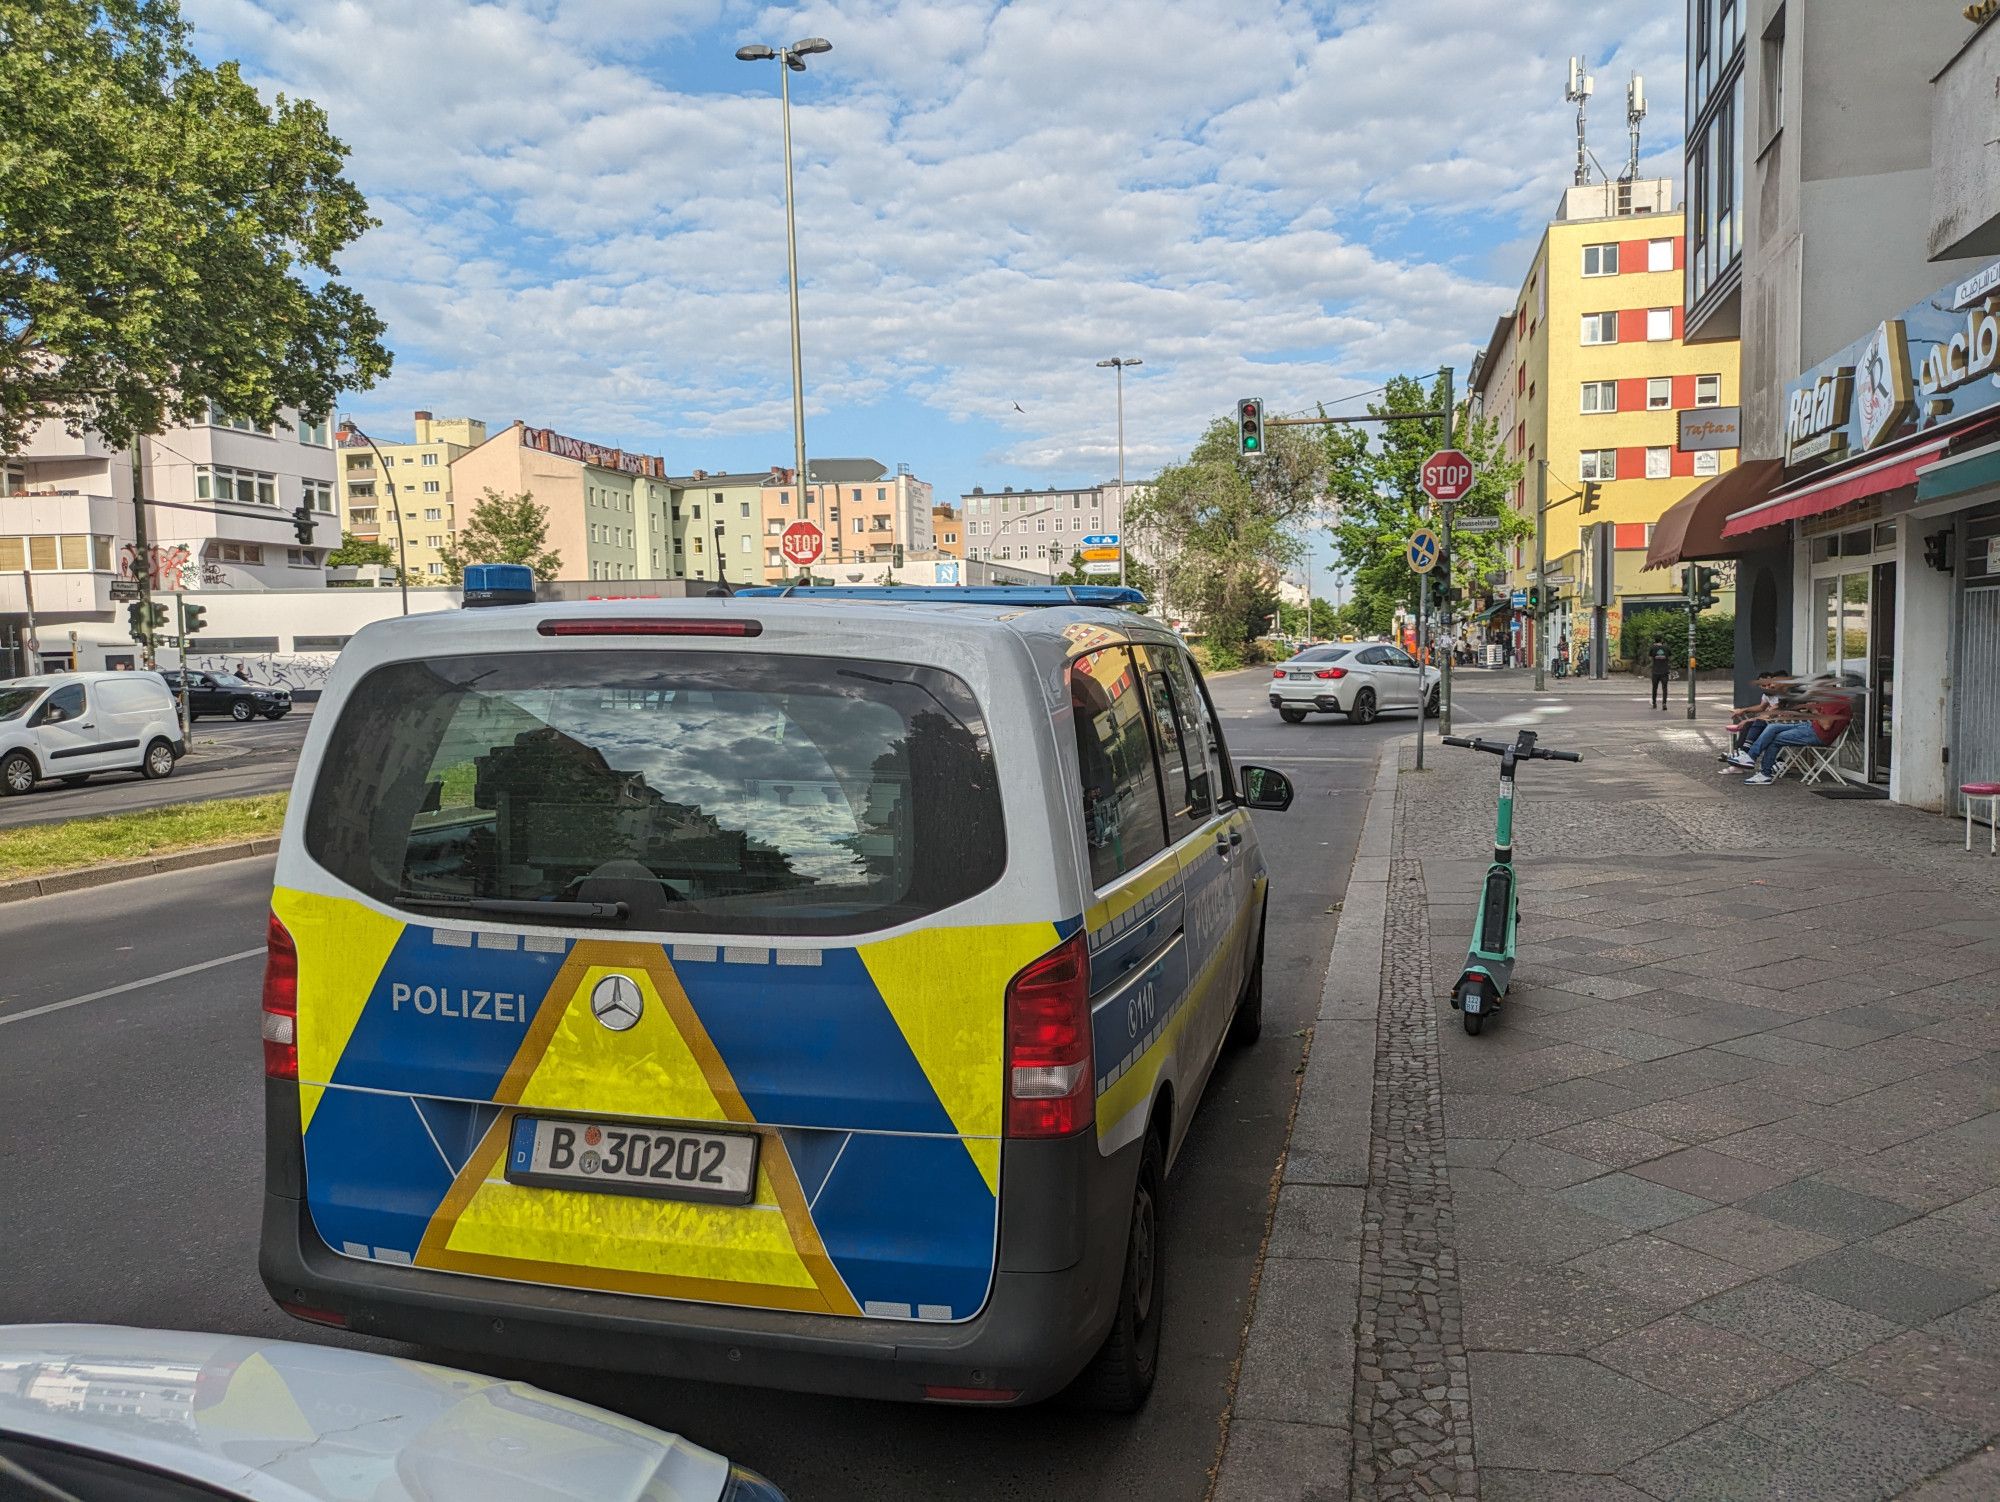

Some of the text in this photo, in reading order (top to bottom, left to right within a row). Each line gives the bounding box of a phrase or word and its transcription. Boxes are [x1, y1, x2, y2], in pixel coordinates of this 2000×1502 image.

[1684, 420, 1736, 441] Taftan
[1426, 465, 1469, 486] STOP
[784, 534, 821, 552] STOP
[392, 982, 526, 1023] POLIZEI
[1138, 981, 1155, 1029] 110
[517, 1151, 526, 1163] D
[549, 1127, 727, 1183] B 30202
